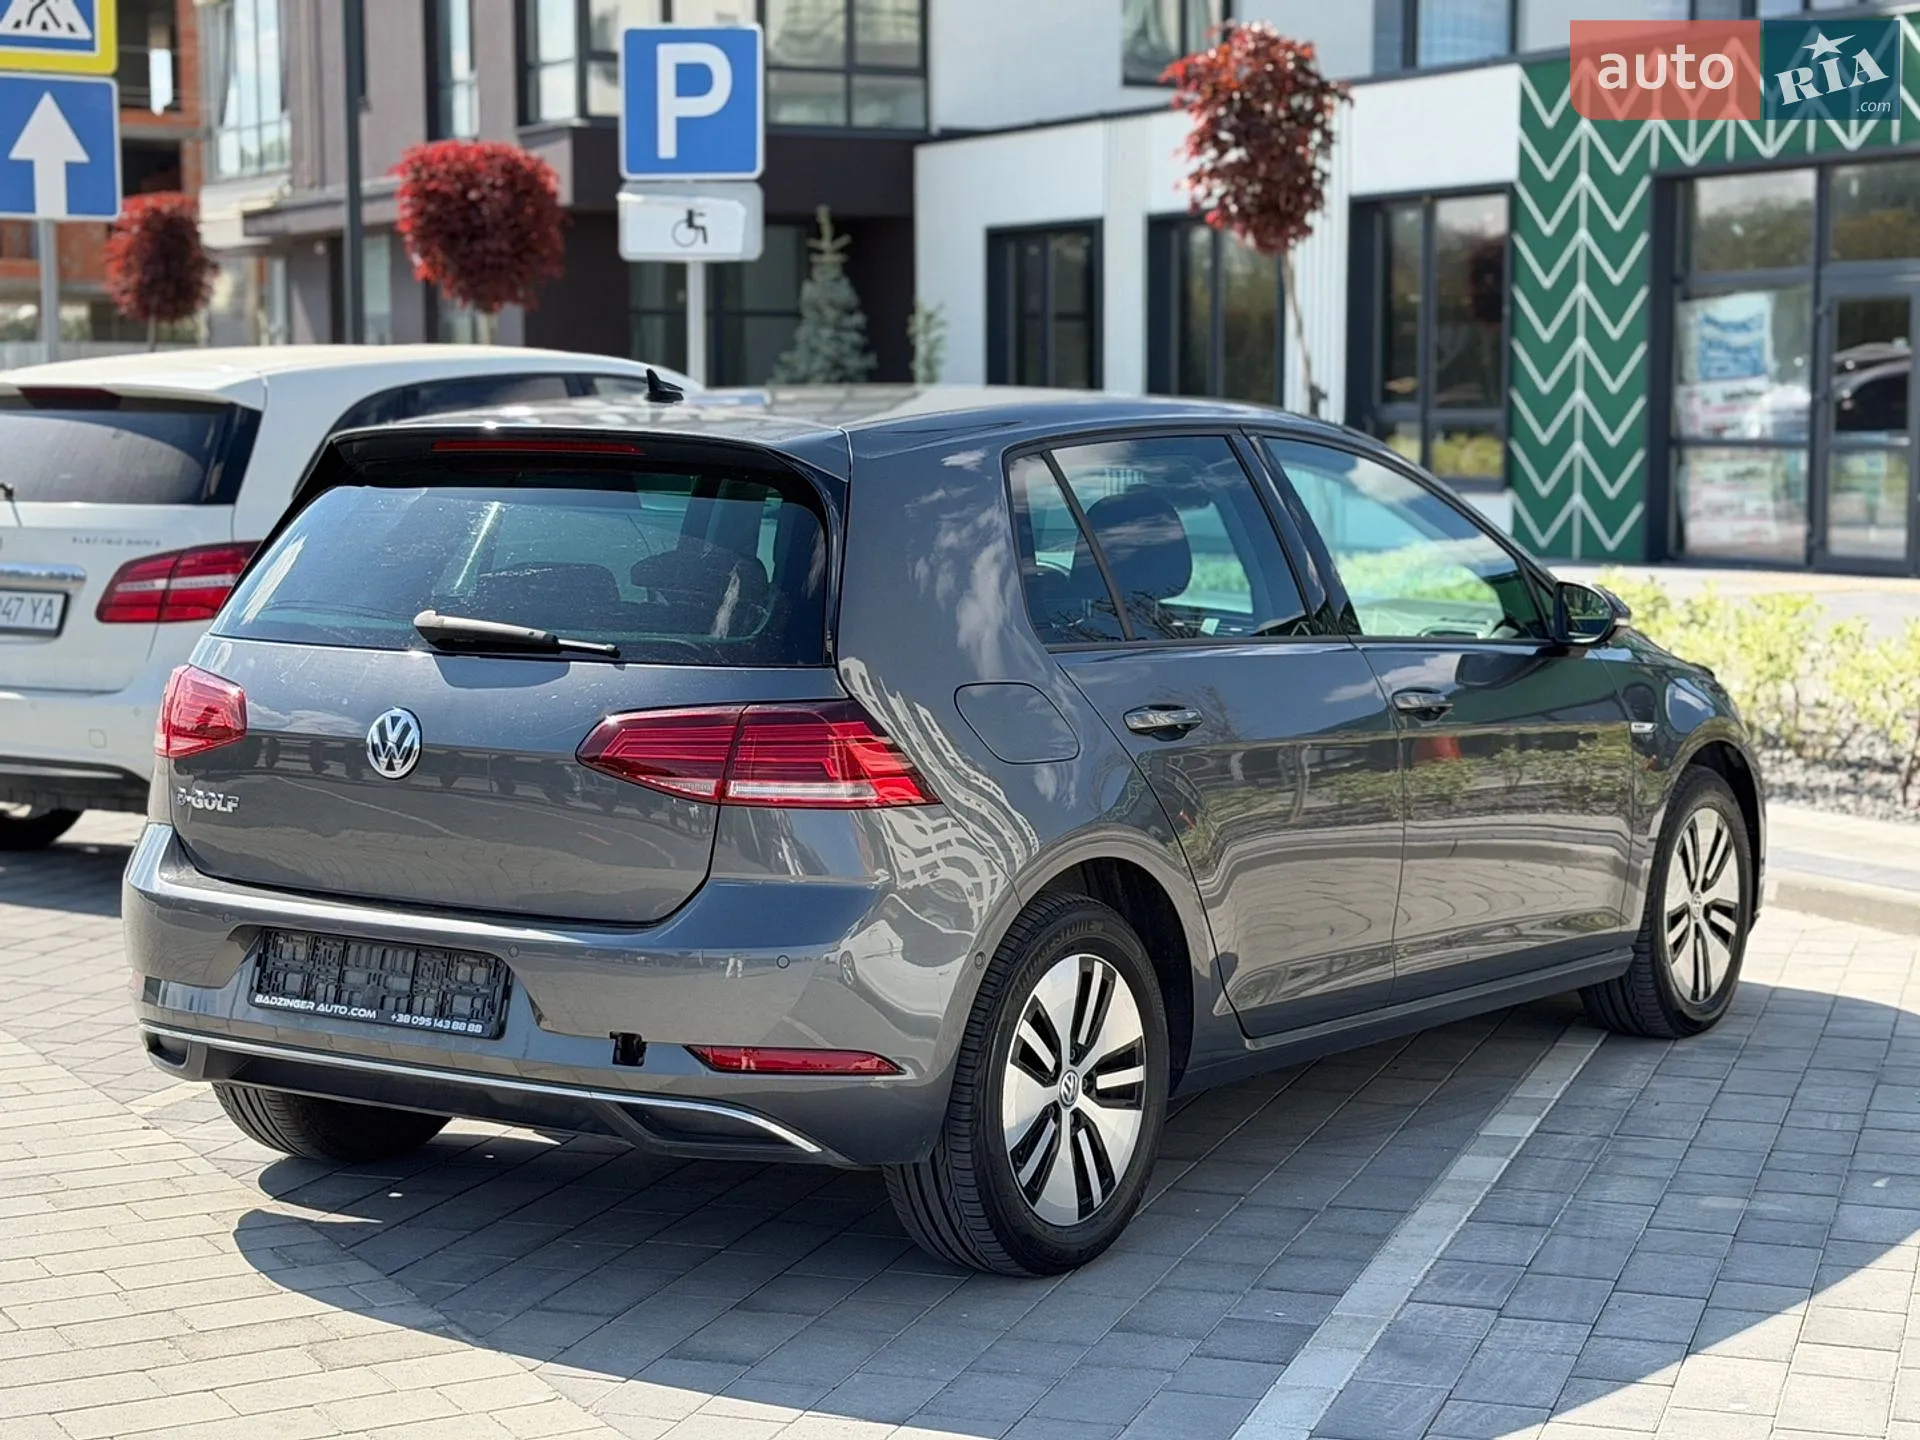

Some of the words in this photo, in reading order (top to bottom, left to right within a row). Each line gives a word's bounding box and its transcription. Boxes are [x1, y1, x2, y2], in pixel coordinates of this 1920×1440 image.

[657, 43, 733, 159] P
[0, 596, 24, 624] 47
[255, 994, 315, 1010] BADZINGER
[391, 1013, 411, 1024] +38
[411, 1015, 432, 1027] 095
[433, 1018, 451, 1029] 143
